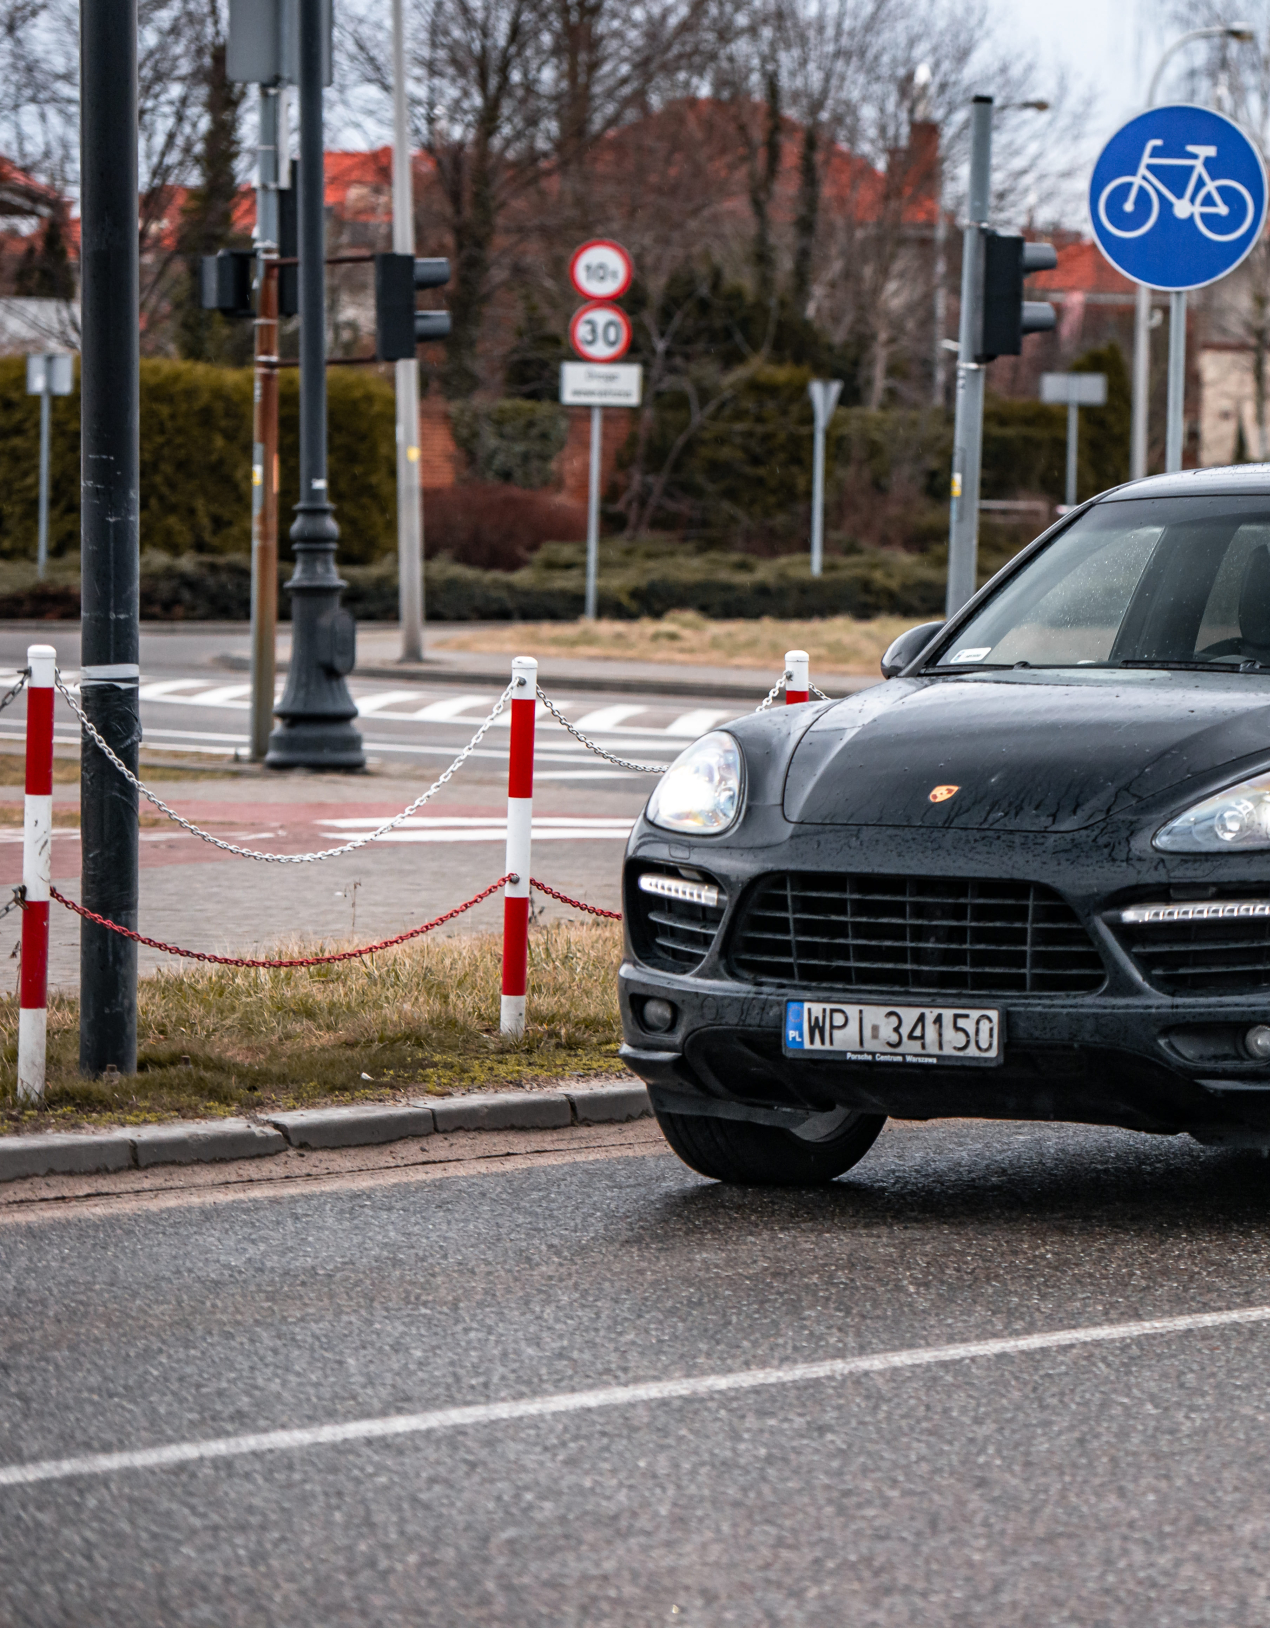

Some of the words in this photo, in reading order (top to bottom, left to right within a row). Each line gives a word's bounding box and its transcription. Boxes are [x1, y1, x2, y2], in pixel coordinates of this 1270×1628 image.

[580, 318, 622, 347] 30
[788, 1030, 802, 1042] PL
[807, 1007, 864, 1048] WPI
[884, 1010, 994, 1053] 34150
[846, 1052, 873, 1061] Porsche
[875, 1053, 903, 1062] Centrum
[905, 1055, 937, 1064] Warszawa
